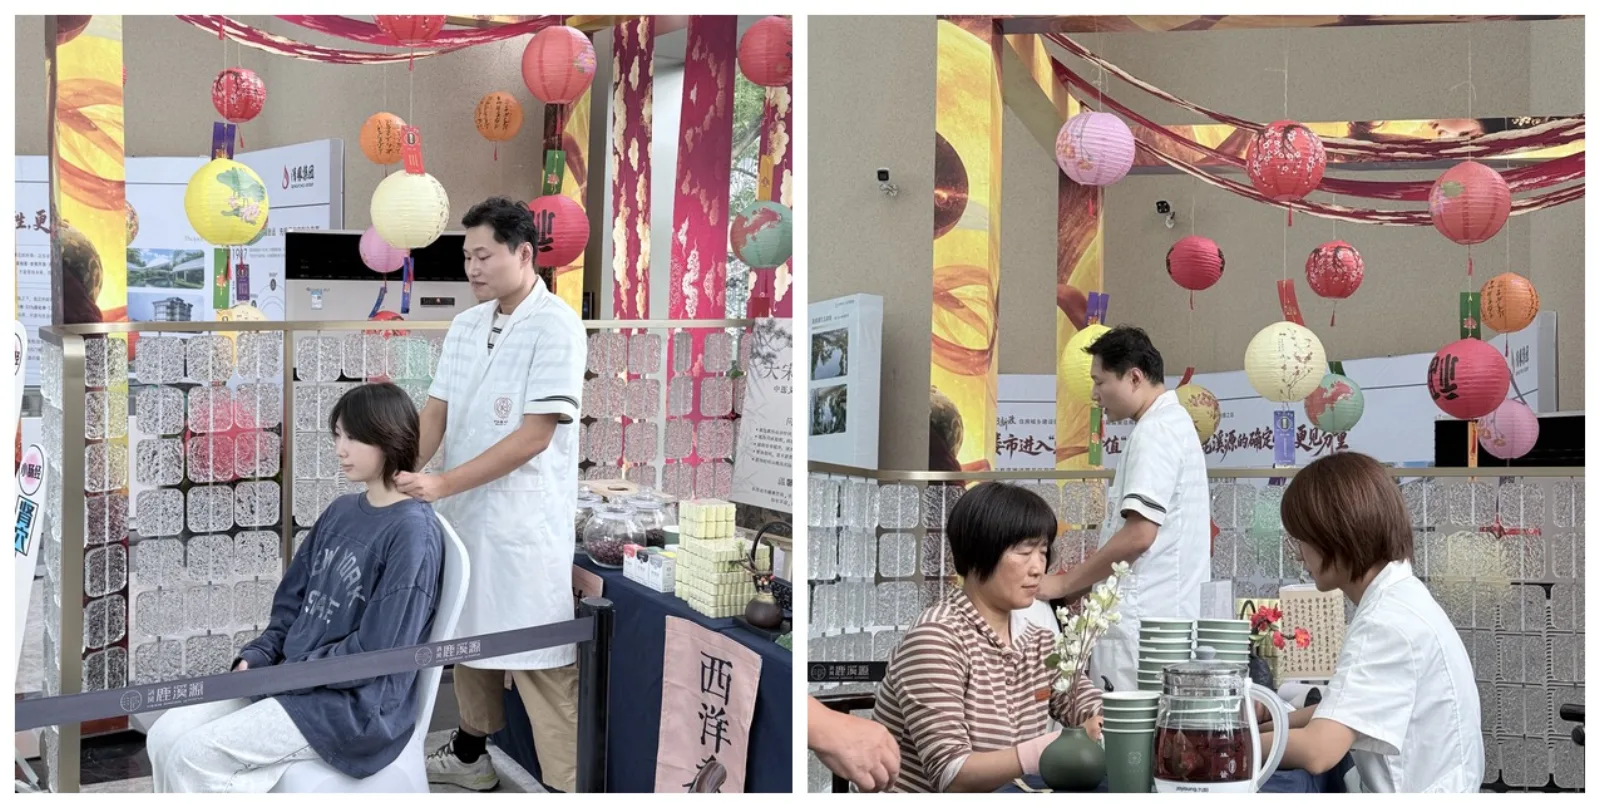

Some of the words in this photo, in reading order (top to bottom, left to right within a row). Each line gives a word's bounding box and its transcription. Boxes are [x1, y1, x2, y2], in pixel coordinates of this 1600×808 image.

[20, 462, 41, 480] 小肠经
[336, 548, 365, 609] YORK
[156, 681, 204, 702] 鹿溪源
